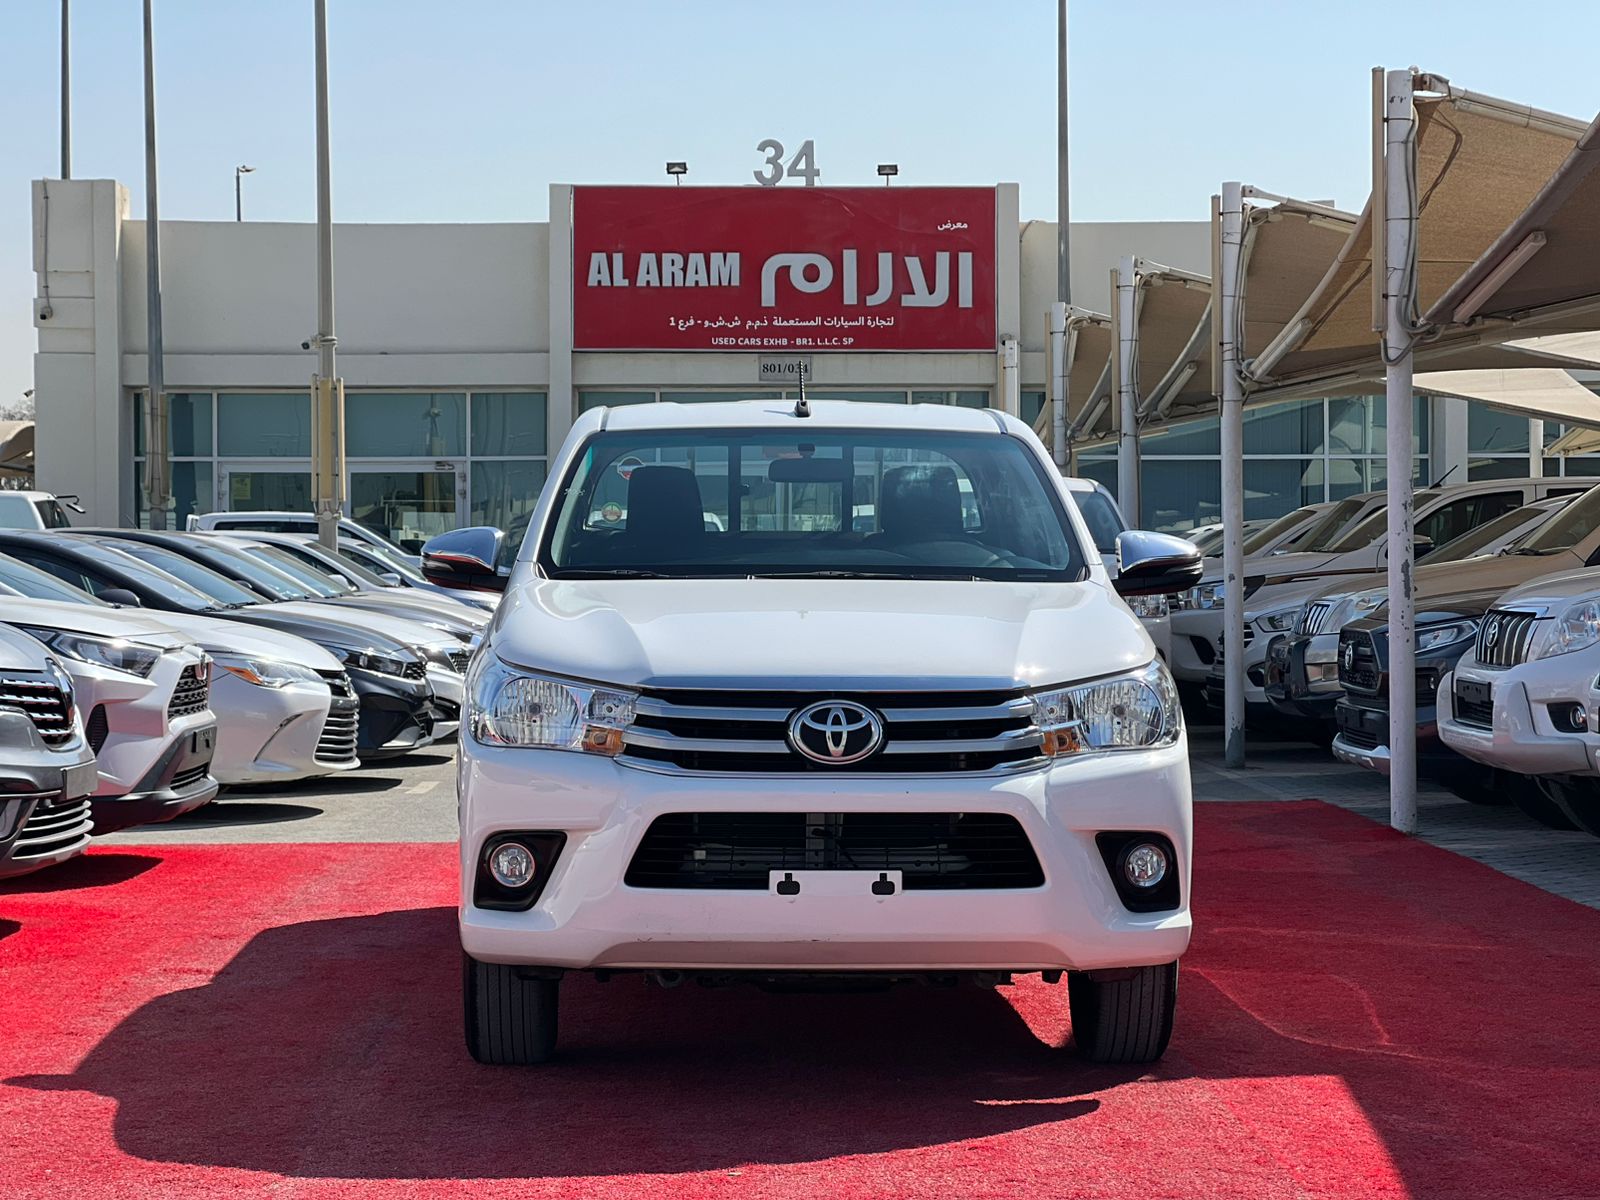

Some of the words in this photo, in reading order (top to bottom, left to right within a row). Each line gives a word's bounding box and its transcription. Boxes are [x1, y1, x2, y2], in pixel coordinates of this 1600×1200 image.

[753, 139, 820, 187] 34
[937, 219, 969, 232] معرض
[587, 252, 629, 287] AL
[636, 252, 740, 287] ARAM
[761, 249, 973, 308] الارام
[669, 316, 676, 326] 1
[677, 315, 695, 331] فرع
[772, 316, 822, 327] المستعملة
[823, 316, 865, 328] السيارات
[866, 316, 894, 328] لتجارة
[711, 337, 736, 345] USED
[737, 338, 762, 346] CARS
[763, 338, 788, 346] EXHB
[795, 338, 816, 346] BR1.
[817, 338, 841, 346] L.L.C.
[842, 337, 854, 345] SP
